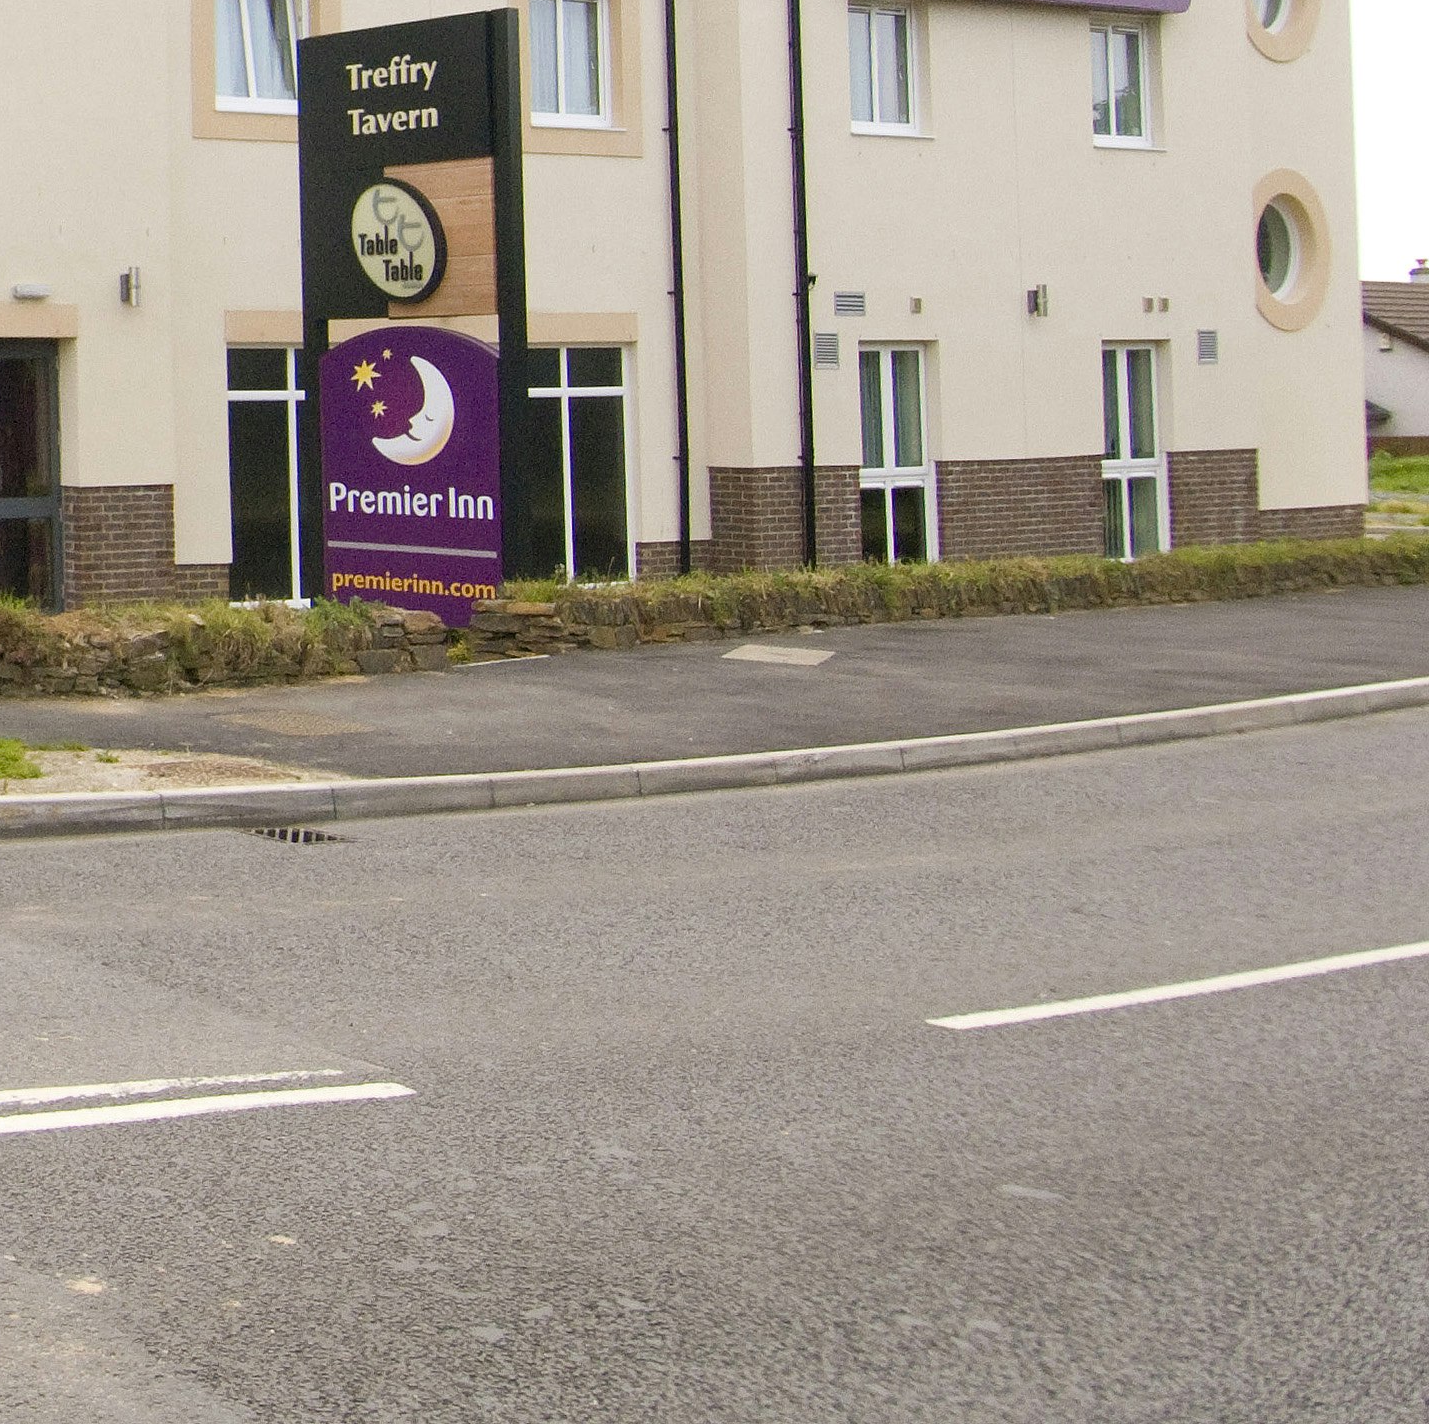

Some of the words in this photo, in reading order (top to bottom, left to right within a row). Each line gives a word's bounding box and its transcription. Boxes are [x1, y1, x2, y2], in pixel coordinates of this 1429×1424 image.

[345, 54, 438, 91] Treffry
[347, 107, 439, 135] Tavern
[358, 224, 399, 256] Table
[382, 251, 424, 282] Table
[328, 481, 444, 518] Premier
[447, 487, 495, 521] Inn
[331, 571, 498, 600] premierinn.com
